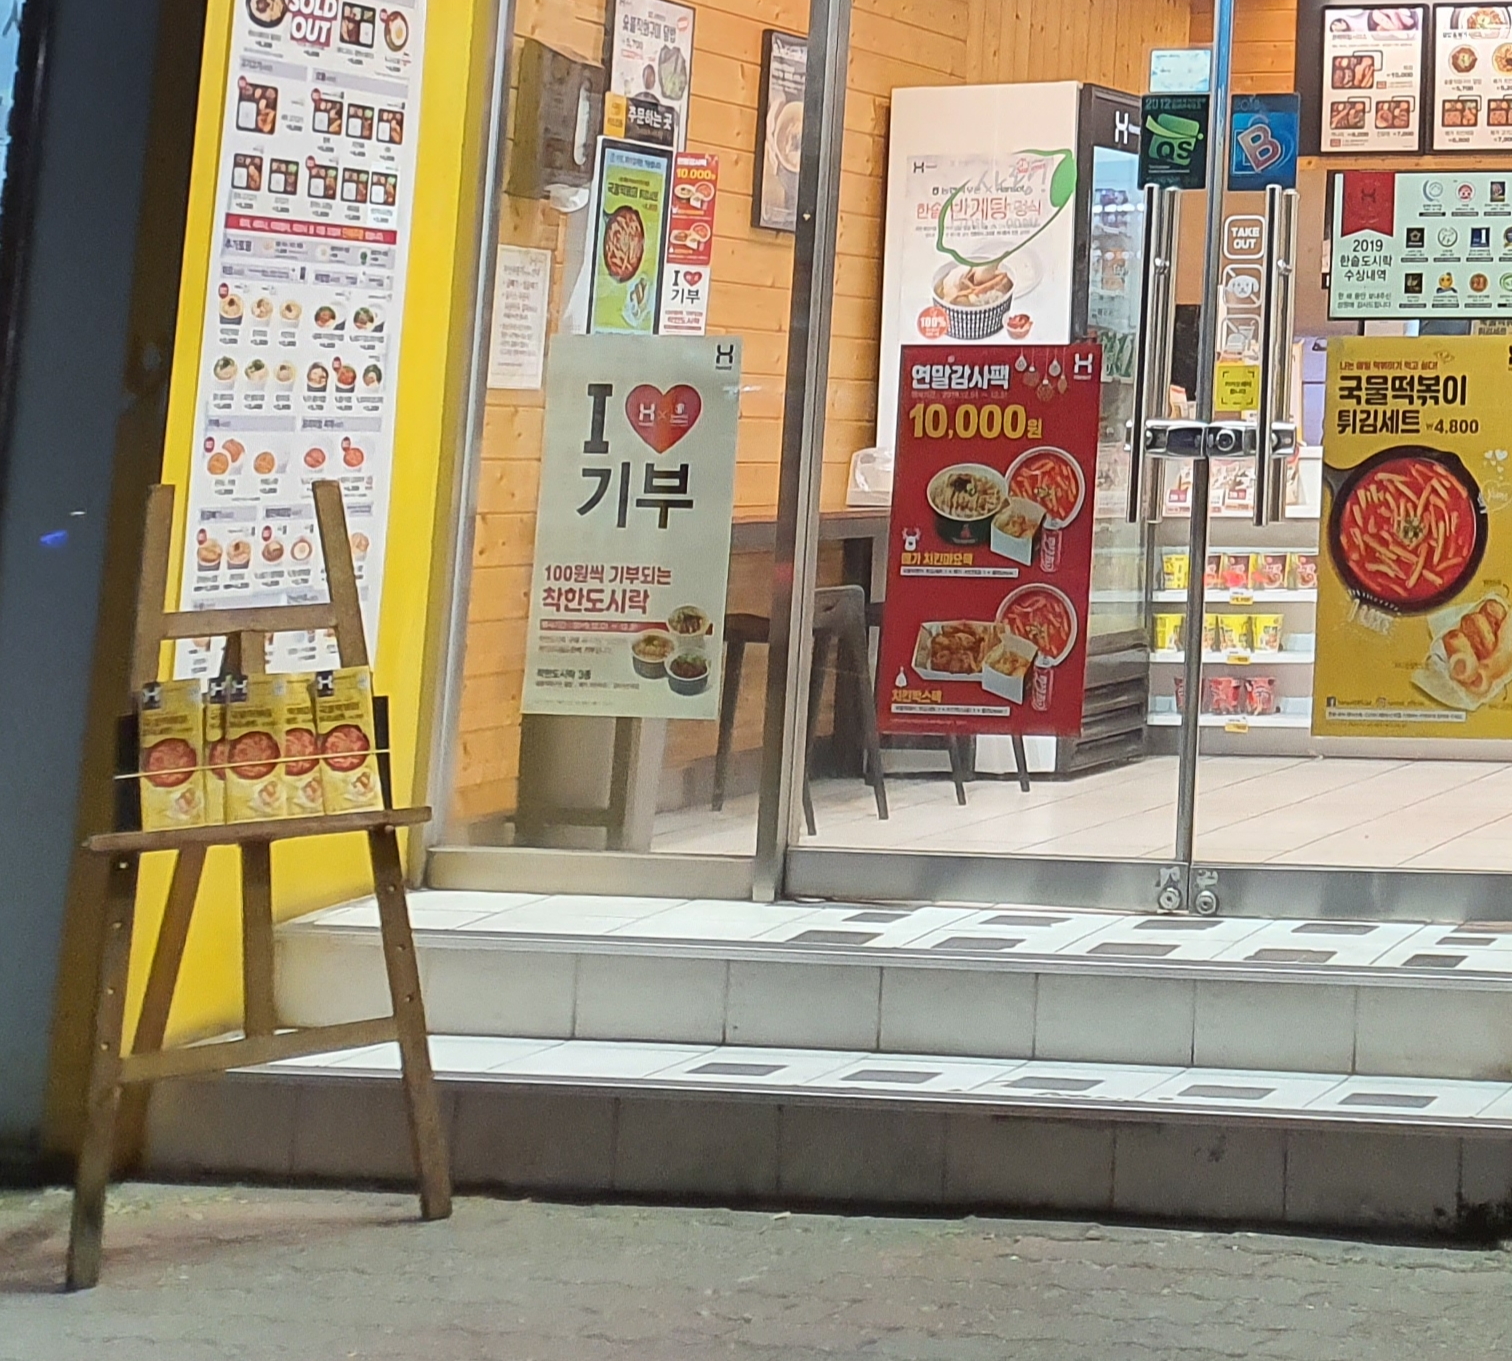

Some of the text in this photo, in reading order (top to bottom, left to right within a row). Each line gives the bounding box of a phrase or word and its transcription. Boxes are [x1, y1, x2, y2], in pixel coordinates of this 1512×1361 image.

[291, 16, 332, 43] OUT
[628, 105, 662, 128] 주문하는
[663, 113, 673, 130] 곳
[1156, 141, 1192, 161] QS
[1231, 227, 1260, 238] TAKE
[1233, 239, 1257, 249] OUT
[1352, 239, 1384, 253] 2019
[1340, 255, 1392, 267] 한솥도시락
[1344, 269, 1386, 282] 수상내역
[671, 288, 700, 305] 기부
[912, 364, 1009, 390] 연말감사팩
[1338, 375, 1467, 406] 국물떡볶이
[909, 403, 1043, 439] 10,000원
[1337, 409, 1420, 435] 튀김세트
[576, 462, 694, 529] 기부
[544, 564, 672, 585] 100원씩 기부되는
[542, 587, 650, 614] 착한도시락
